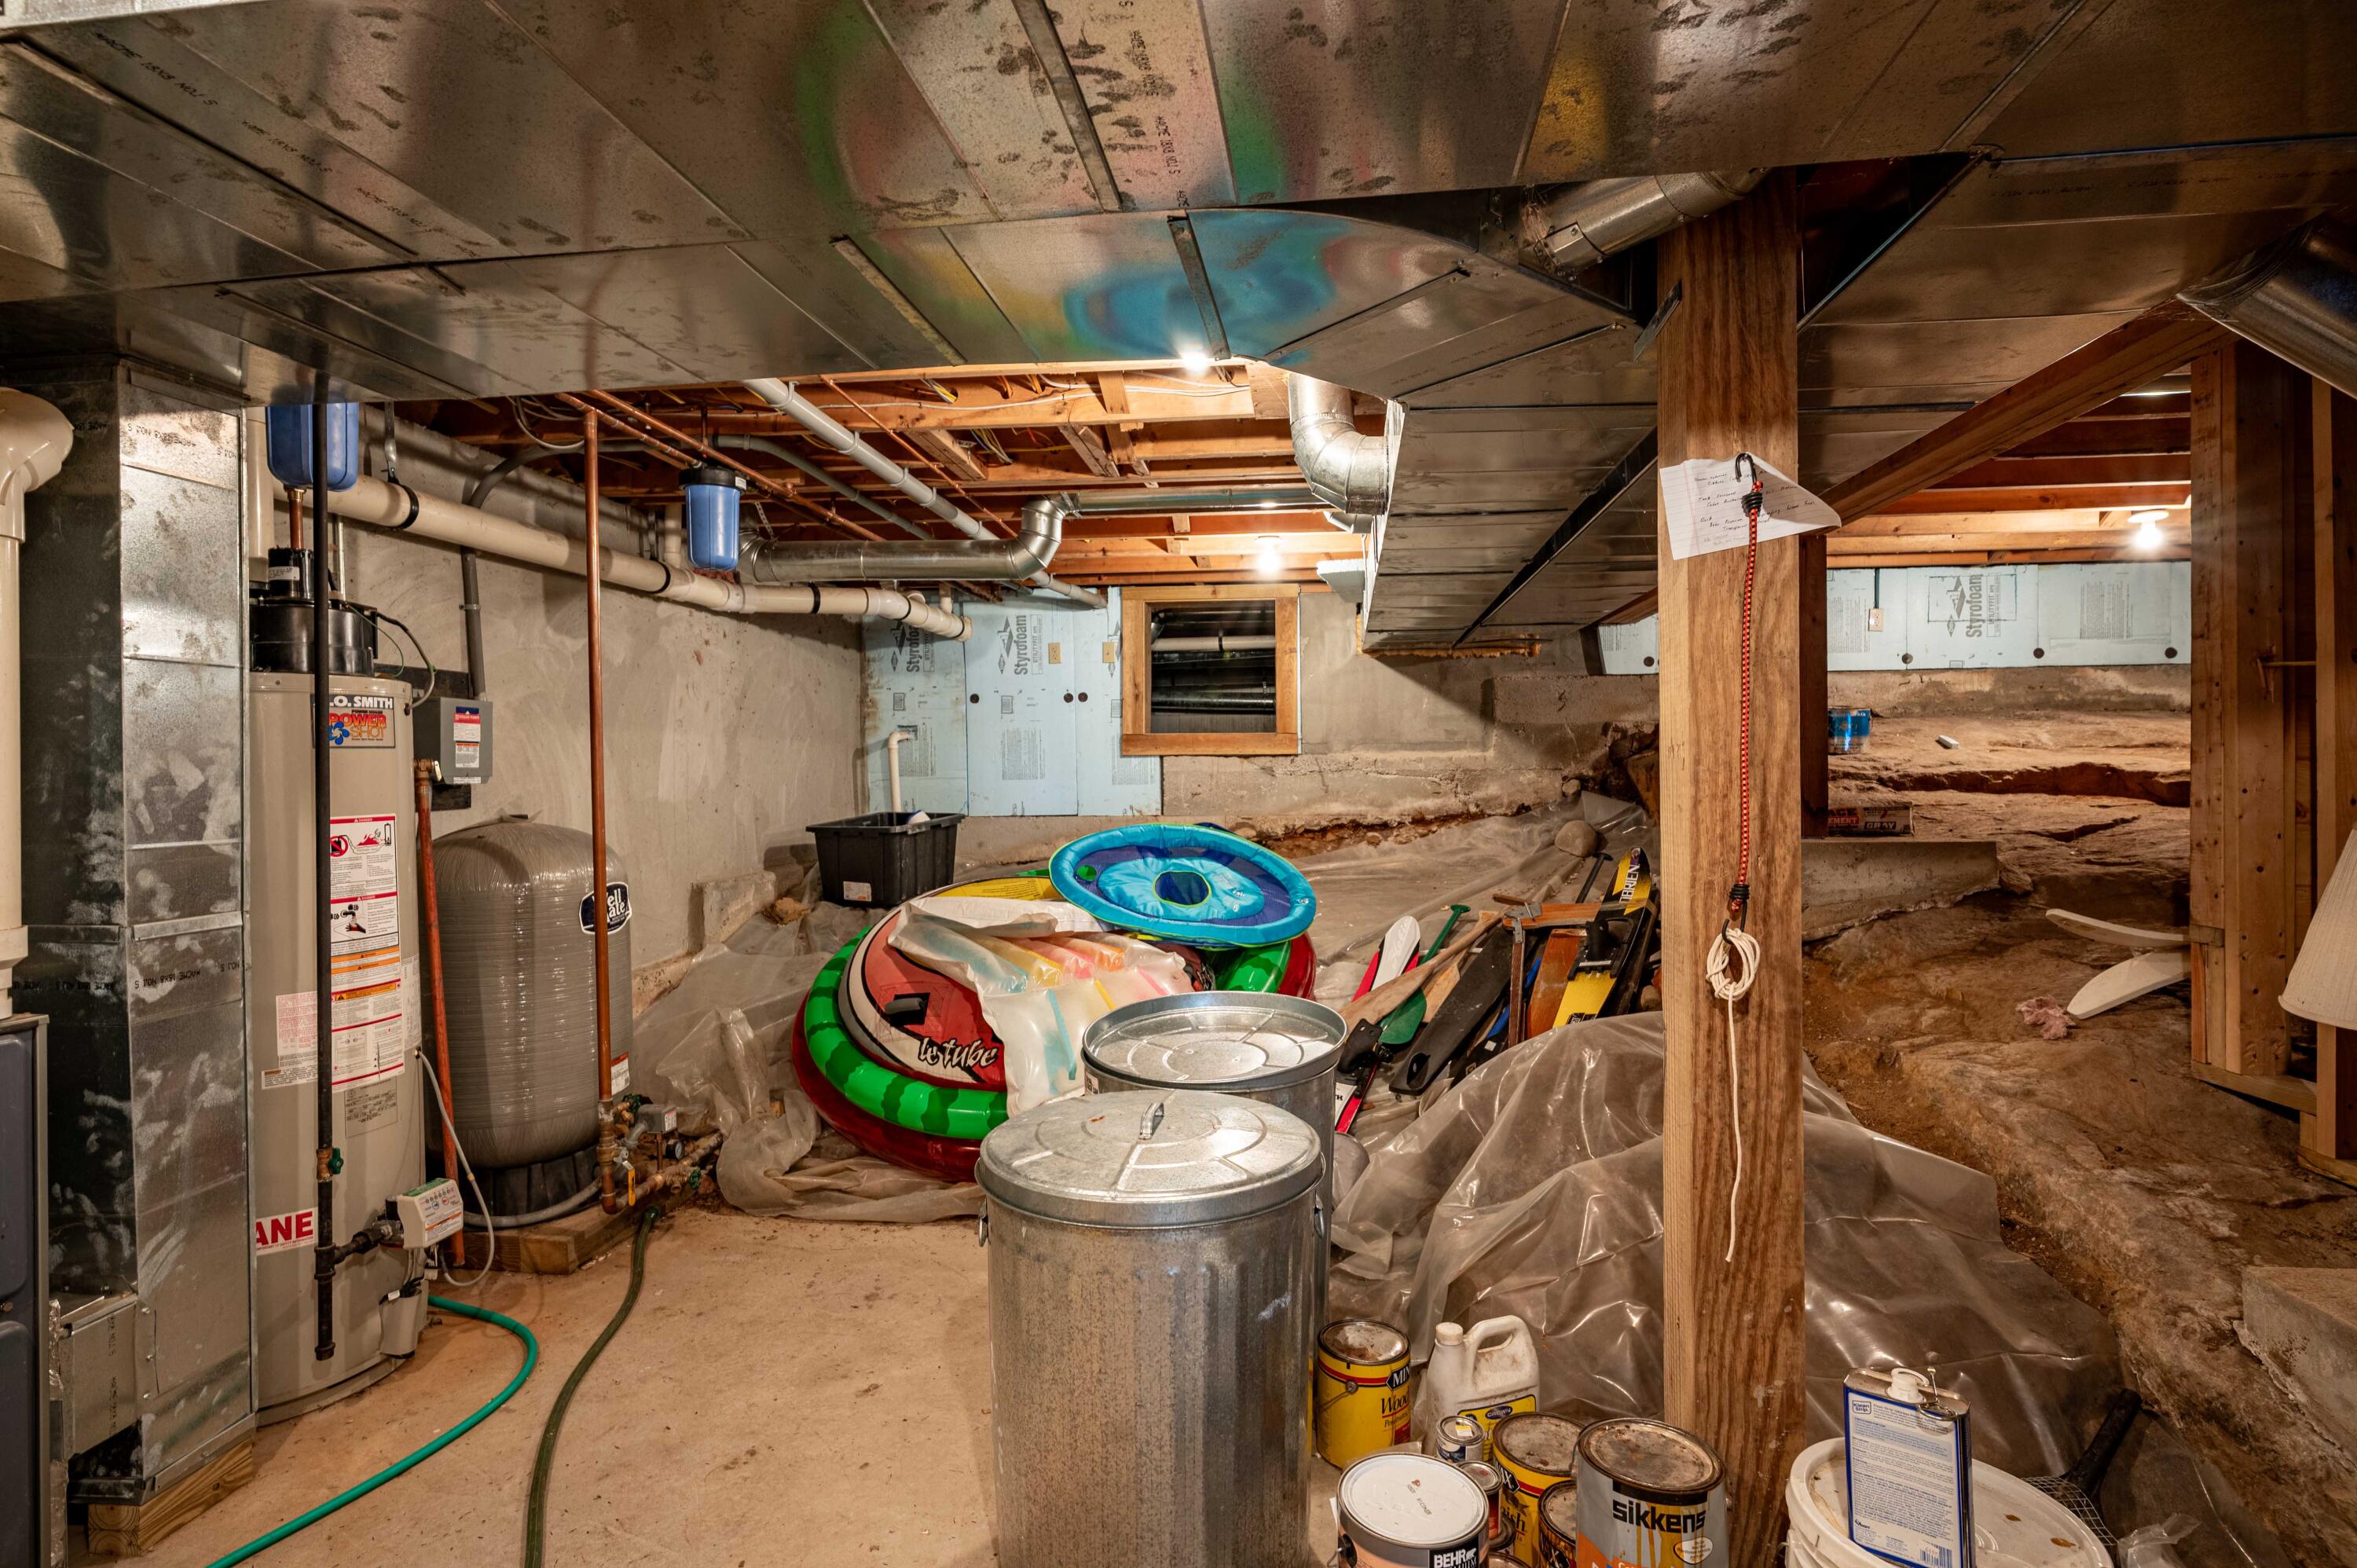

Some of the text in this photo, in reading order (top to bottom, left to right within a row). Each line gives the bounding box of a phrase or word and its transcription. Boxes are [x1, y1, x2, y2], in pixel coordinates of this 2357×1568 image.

[1967, 573, 1985, 638] Styrofoam
[1014, 615, 1031, 676] Styrofoam
[329, 696, 393, 709] .O. SMITH
[328, 713, 387, 729] POWER
[350, 726, 383, 738] SHOT
[134, 980, 140, 989] S
[942, 1038, 999, 1069] tube
[1434, 1549, 1466, 1568] BEHR
